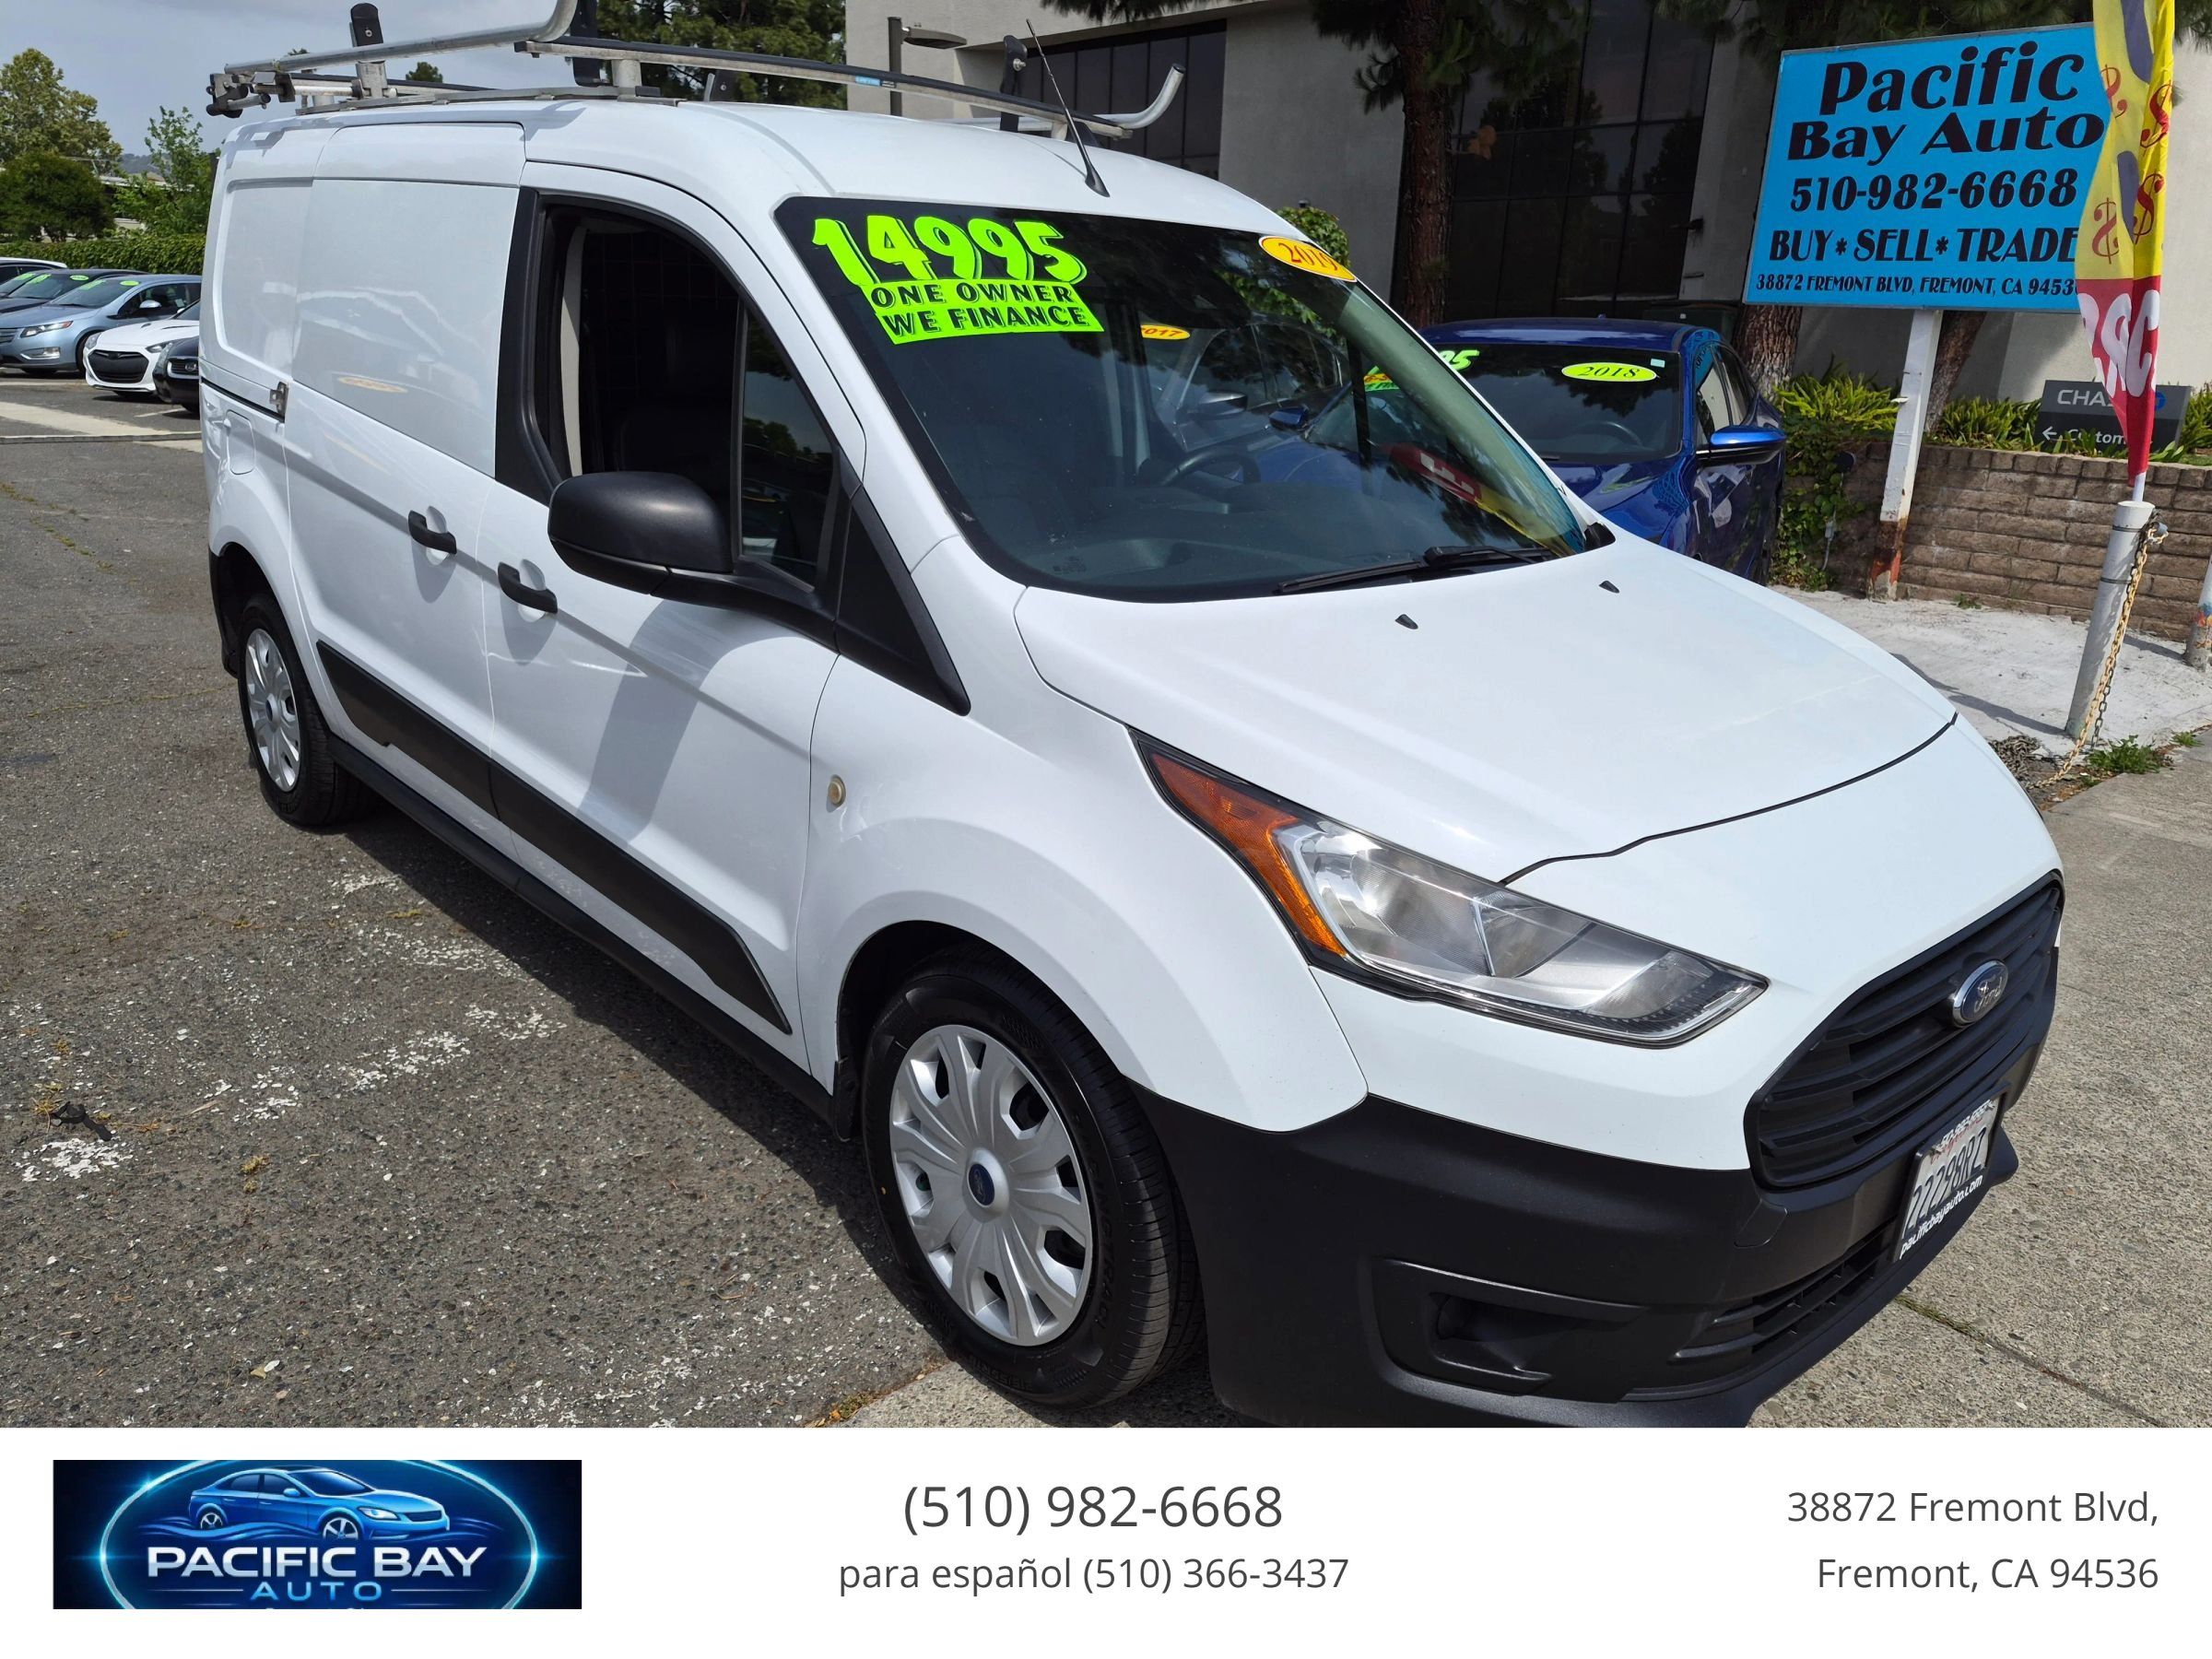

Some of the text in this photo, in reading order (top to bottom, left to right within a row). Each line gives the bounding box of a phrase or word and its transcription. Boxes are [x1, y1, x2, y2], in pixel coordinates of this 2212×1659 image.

[1819, 41, 2085, 115] Pacific
[1787, 107, 2104, 166] Bay Auto
[1790, 169, 2078, 212] 510-982-6668
[812, 215, 1088, 285] 14995
[1278, 242, 1338, 271] 2019
[1957, 228, 2079, 262] TRADE
[870, 282, 1075, 308] ONE OWNER
[1756, 274, 2077, 297] 38872 FREMONT BLVD, FREMONT, CA 9453
[882, 305, 1090, 337] WE FINANCE
[1578, 365, 1641, 380] 2018
